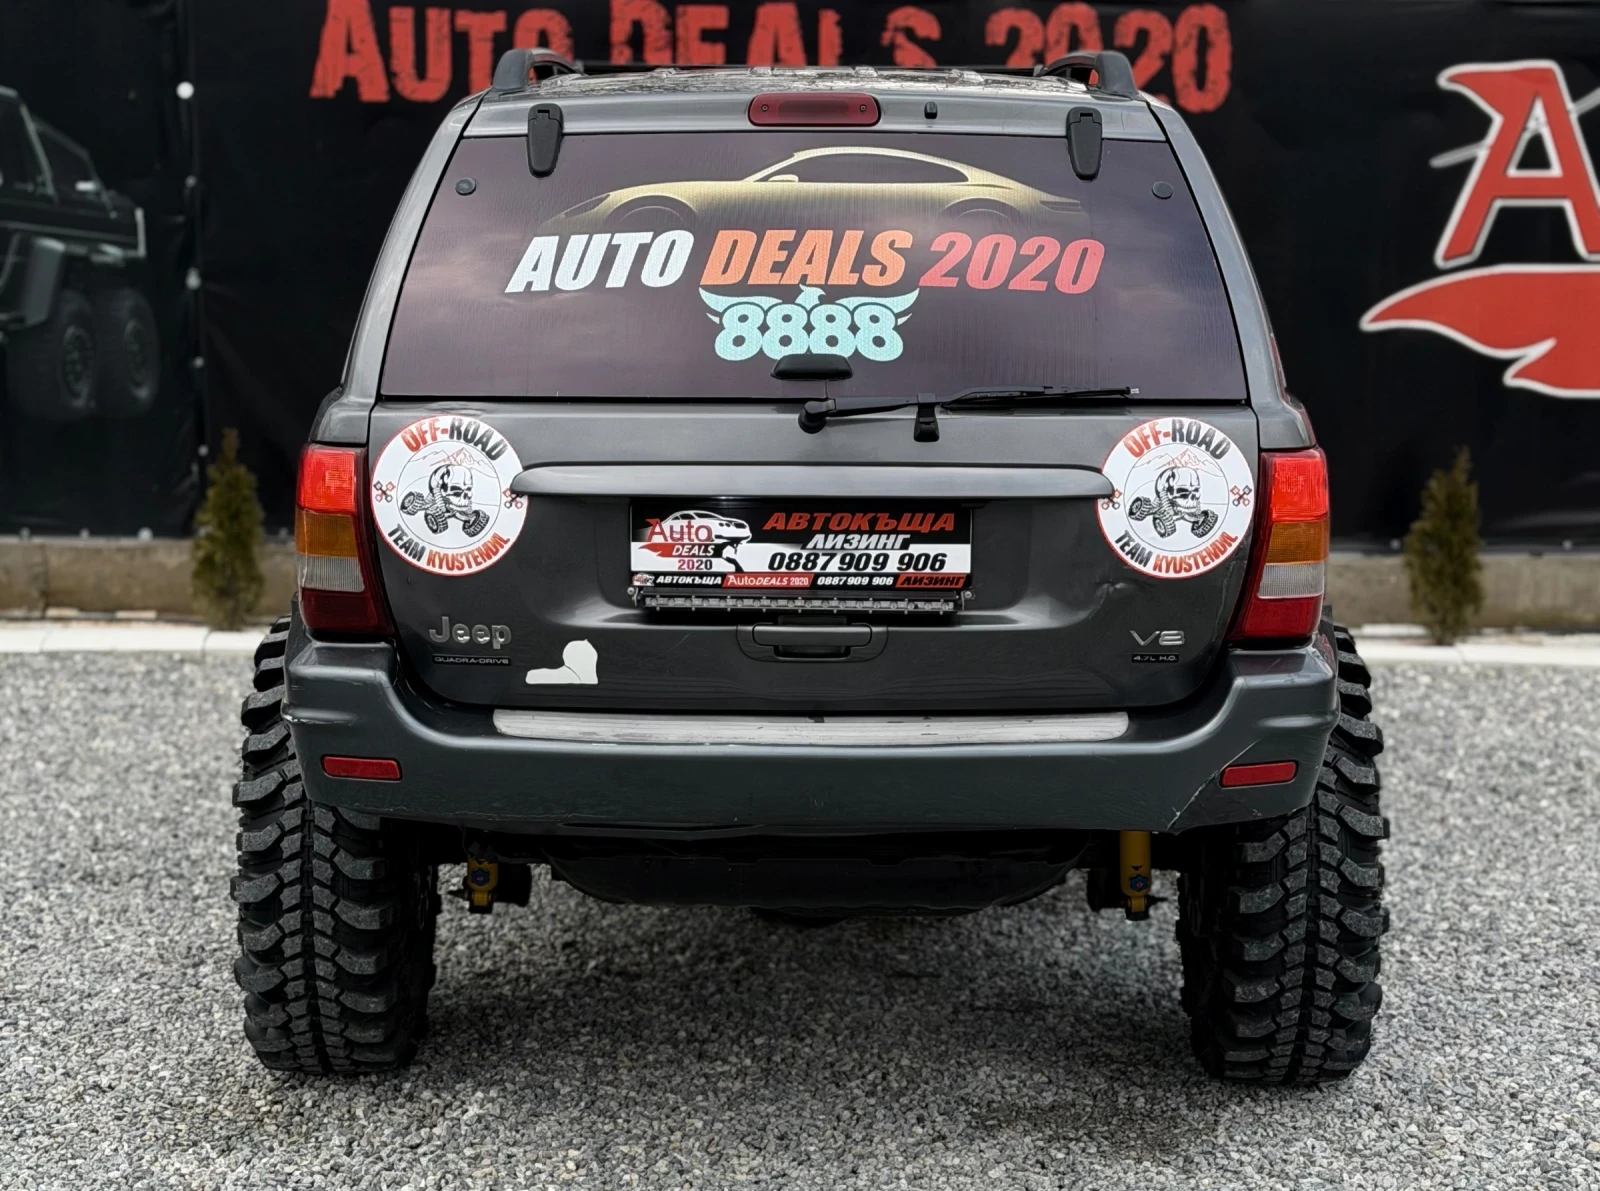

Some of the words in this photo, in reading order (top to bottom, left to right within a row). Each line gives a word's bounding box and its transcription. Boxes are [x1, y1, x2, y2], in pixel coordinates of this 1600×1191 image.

[504, 229, 695, 294] AUTO
[700, 229, 913, 287] DEALS
[920, 232, 1105, 294] 2020
[714, 302, 904, 362] 8888
[401, 416, 507, 462] OFF-ROAD
[1123, 418, 1231, 461] OFF-ROAD
[645, 518, 713, 543] Auto
[762, 512, 954, 532] АВТОКЪЩА
[387, 522, 426, 563] TEAM
[426, 531, 510, 572] KYUSTENDIL
[671, 545, 715, 557] DEALS
[806, 534, 911, 550] ЛИЗИНГ
[1114, 529, 1153, 568] TEAM
[1153, 530, 1239, 574] KYUSTENDIL
[677, 558, 713, 571] 2020
[768, 552, 836, 572] 0887
[837, 552, 890, 572] 909
[896, 552, 948, 572] 906
[656, 575, 722, 585] АВТОКЪЩА
[790, 577, 809, 586] 2020
[871, 576, 895, 586] 906
[902, 576, 965, 587] ЛИЗИНГ
[429, 616, 512, 650] Jeep
[1129, 630, 1185, 646] V8
[434, 656, 510, 665] QUADRA-DRIVE
